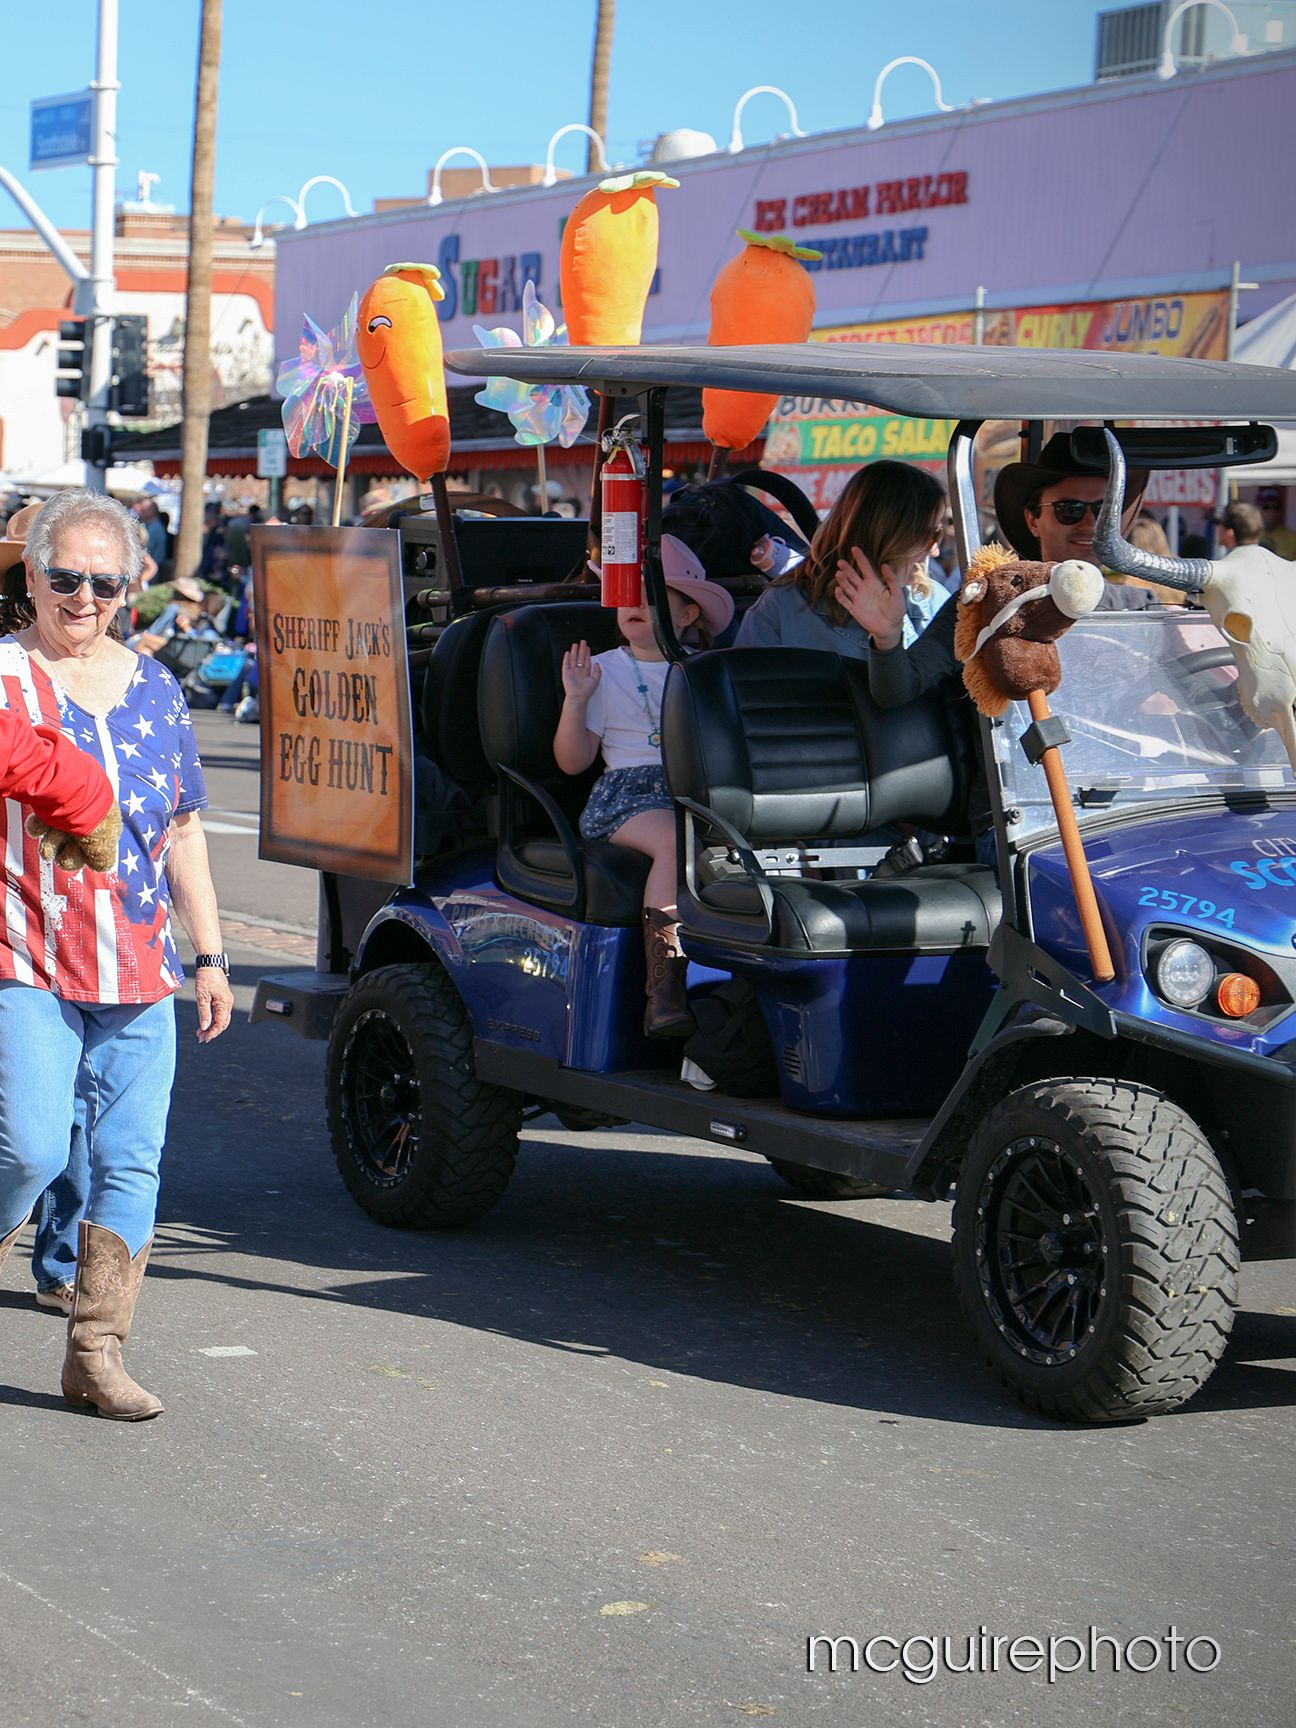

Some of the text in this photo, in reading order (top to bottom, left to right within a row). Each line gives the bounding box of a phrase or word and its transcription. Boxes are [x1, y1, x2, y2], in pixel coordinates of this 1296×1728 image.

[756, 171, 967, 232] ICE CREAM PARLOR
[796, 228, 926, 271] STAURANT
[438, 235, 541, 321] SUGAR
[1104, 300, 1183, 342] JUMBO
[810, 418, 954, 459] TACO SALA
[273, 613, 391, 660] SHERIFF JACK'S
[292, 667, 378, 725] GOLDEN
[279, 733, 394, 796] EGG HUNT
[451, 905, 488, 930] PARKS
[1138, 886, 1236, 929] 25794
[523, 947, 569, 982] 25794
